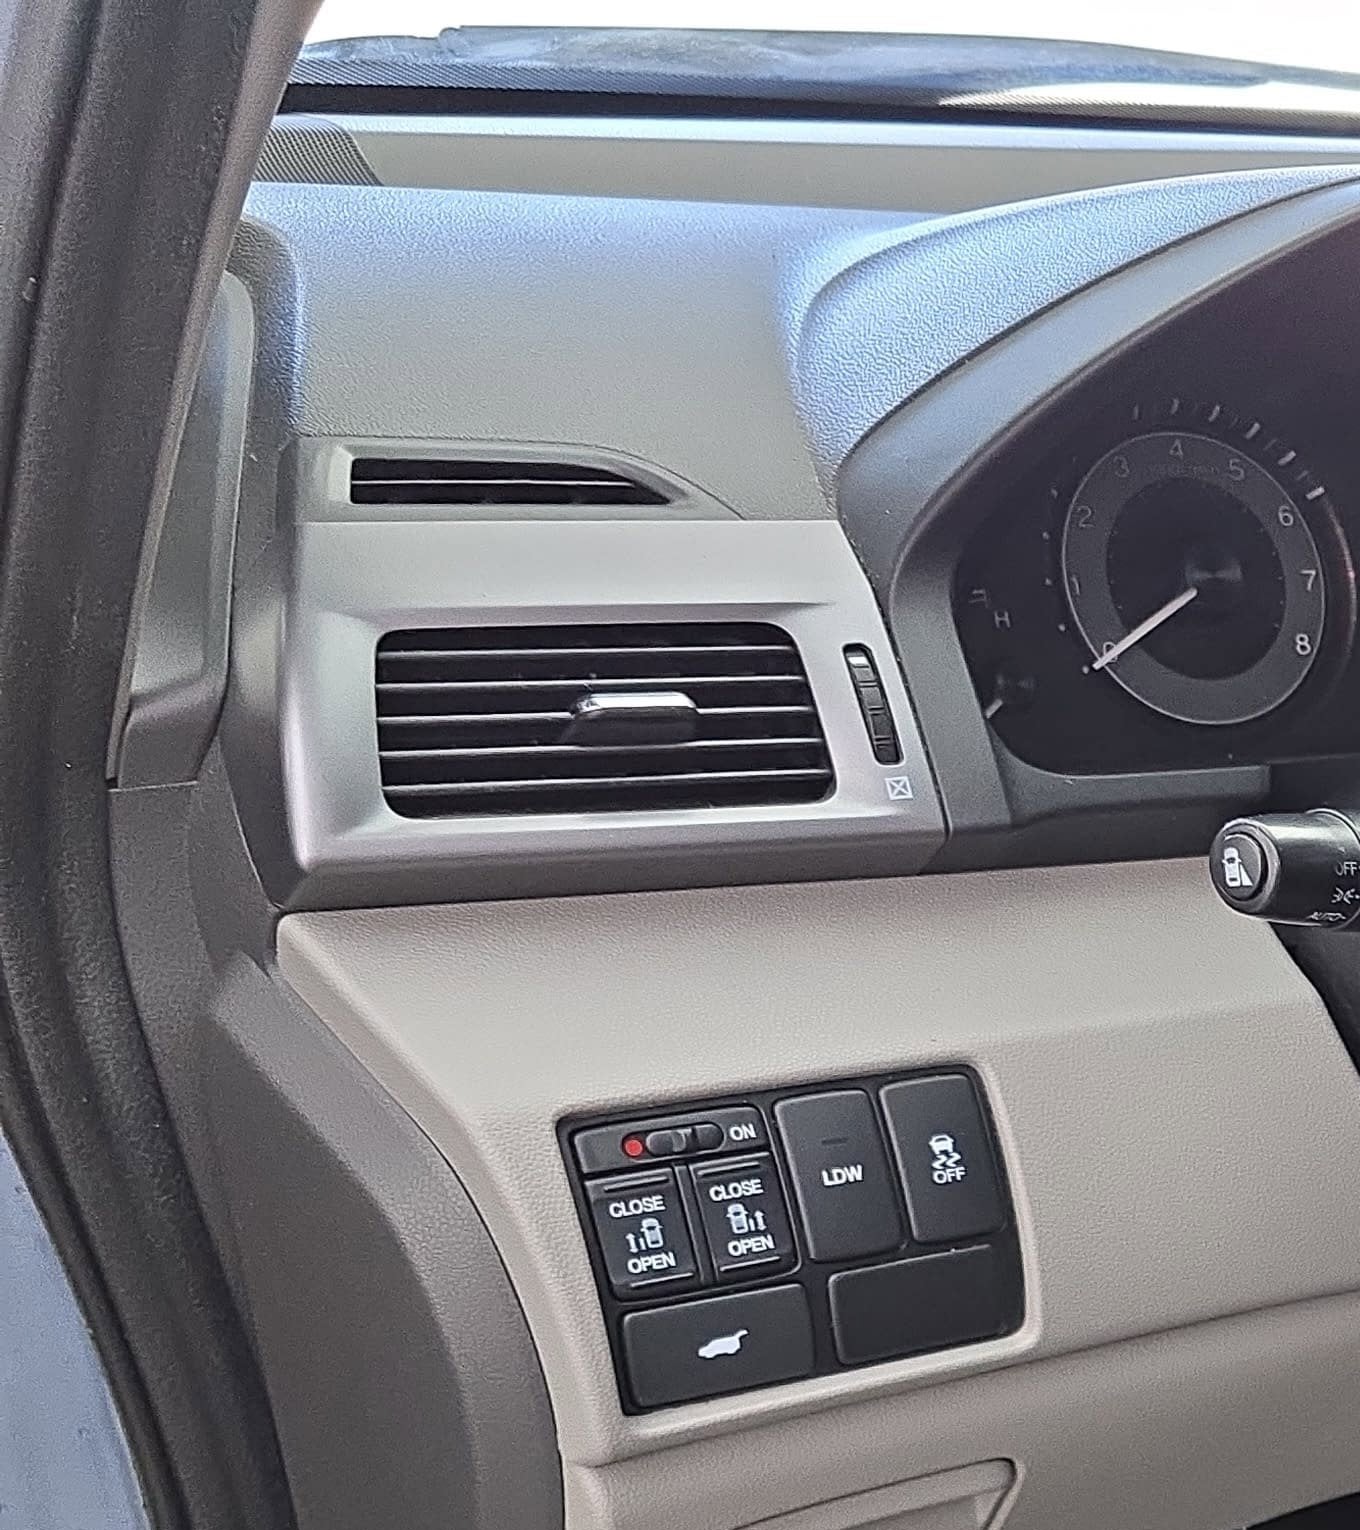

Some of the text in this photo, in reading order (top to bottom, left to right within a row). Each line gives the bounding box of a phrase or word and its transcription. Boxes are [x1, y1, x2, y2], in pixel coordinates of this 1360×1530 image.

[1168, 439, 1184, 458] 4
[1114, 457, 1130, 478] 3
[1228, 459, 1245, 481] 5
[1077, 506, 1095, 529] 2
[1277, 506, 1295, 527] 6
[1299, 569, 1316, 591] 7
[1295, 633, 1312, 655] 8
[1335, 861, 1357, 876] OFF
[729, 1123, 757, 1142] ON
[820, 1164, 865, 1187] LDW
[931, 1166, 967, 1185] OFF
[708, 1178, 765, 1202] CLOSE
[608, 1195, 666, 1219] CLOSE
[727, 1234, 776, 1258] OPEN
[627, 1251, 676, 1275] OPEN
